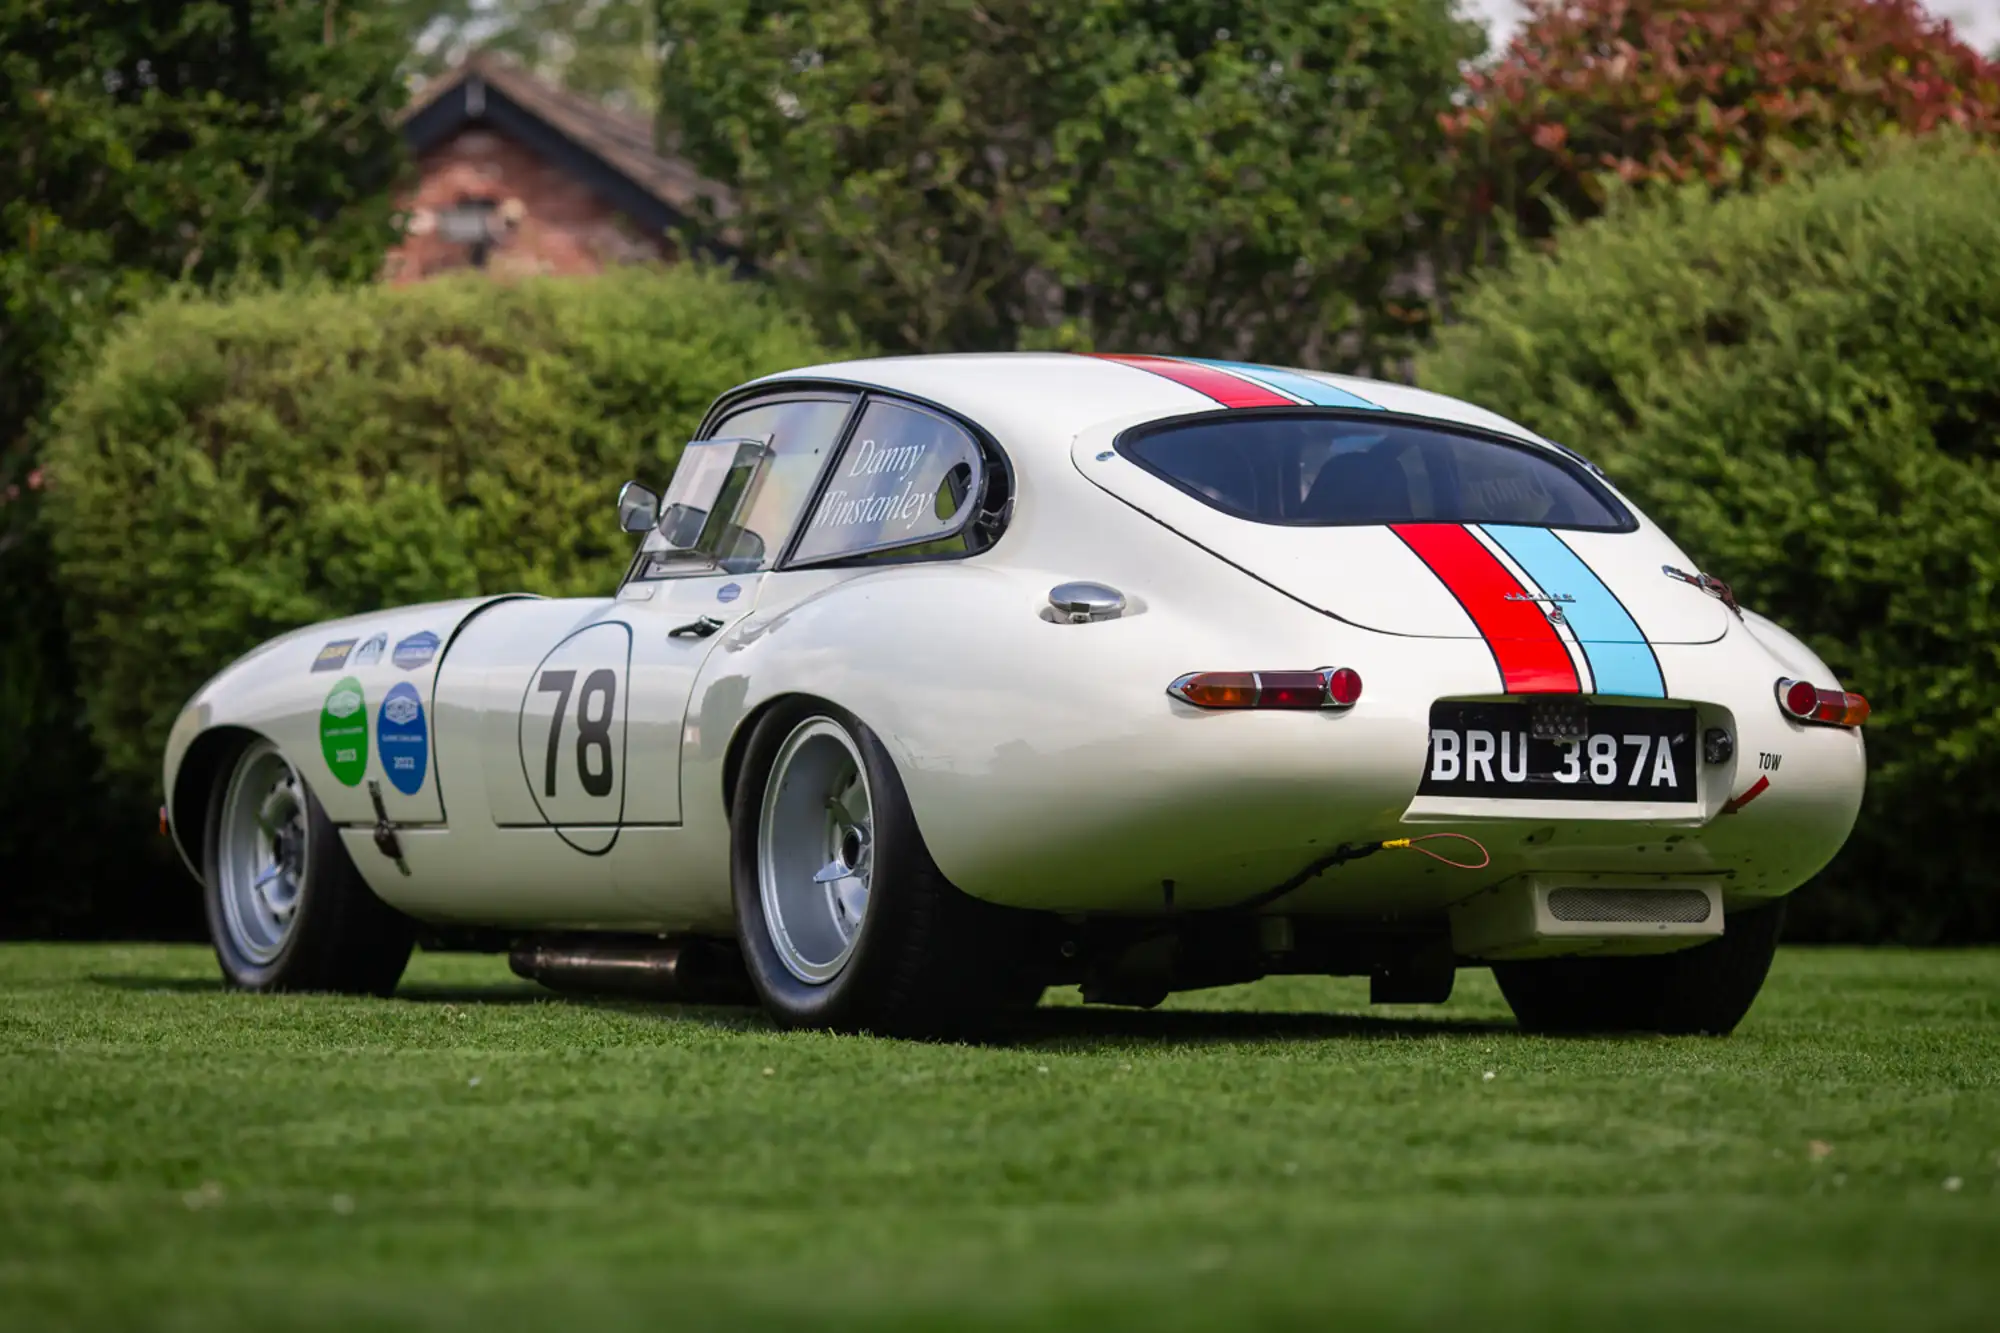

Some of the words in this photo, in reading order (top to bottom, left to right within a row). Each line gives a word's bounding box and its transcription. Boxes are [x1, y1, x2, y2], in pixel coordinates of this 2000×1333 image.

[848, 439, 927, 481] Danny
[812, 480, 935, 530] Winstanley
[537, 668, 617, 798] 78
[1430, 729, 1527, 783] BRU
[1552, 733, 1679, 788] 387A
[1758, 752, 1782, 771] TOW
